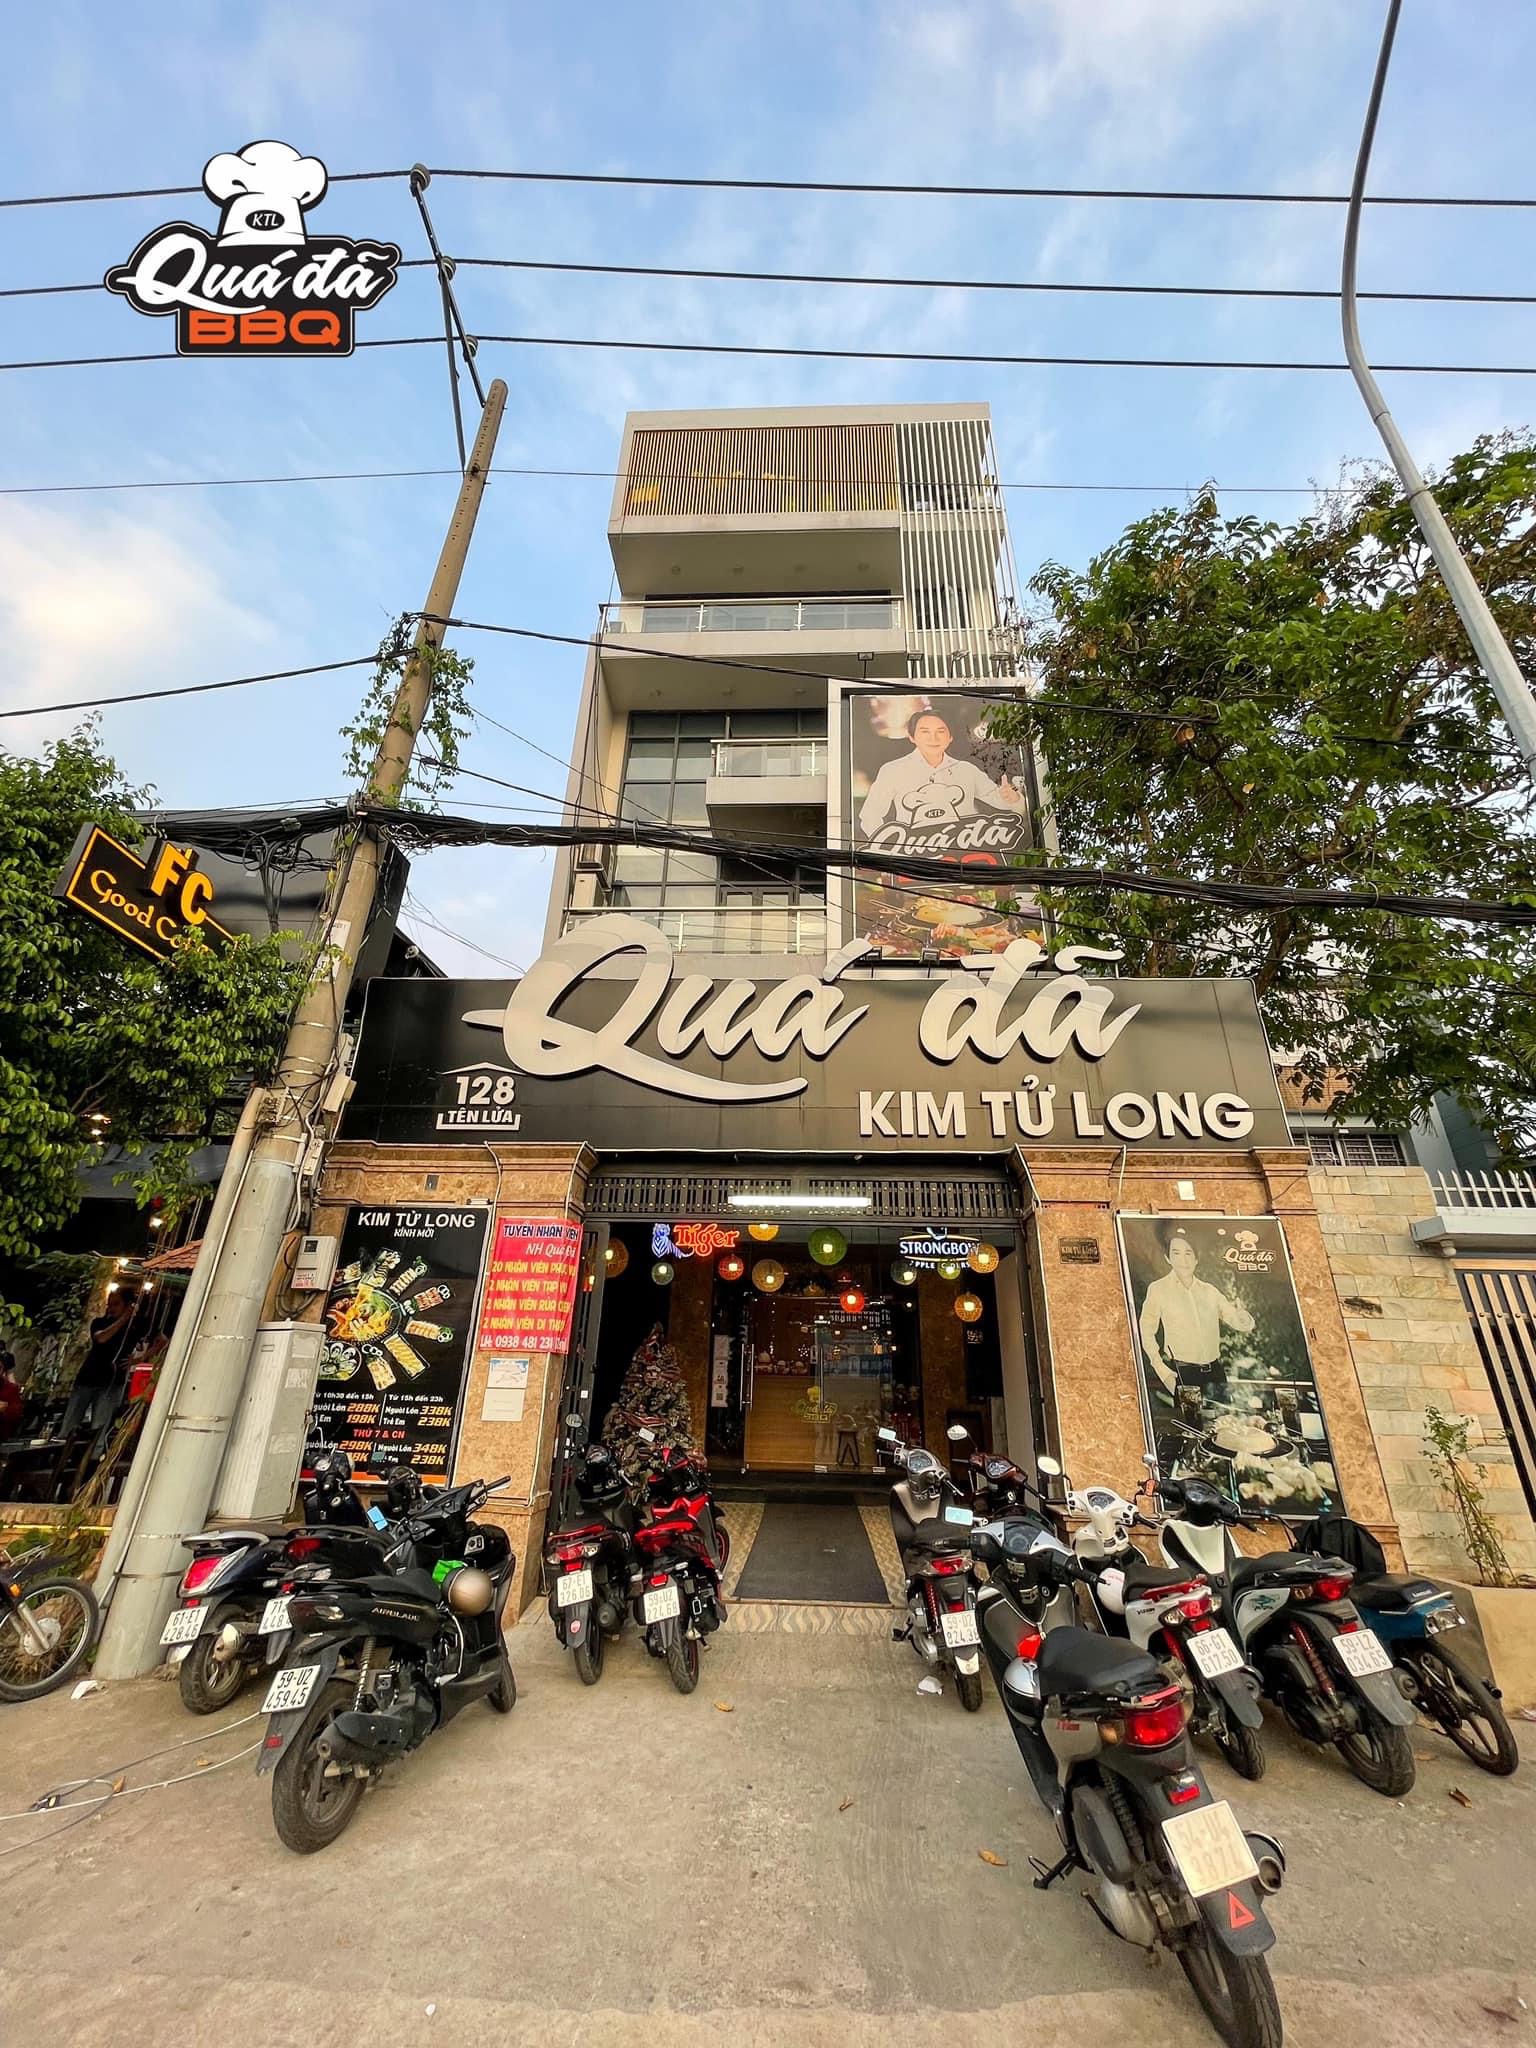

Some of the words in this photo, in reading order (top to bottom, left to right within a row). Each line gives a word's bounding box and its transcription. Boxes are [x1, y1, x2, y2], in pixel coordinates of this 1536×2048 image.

[957, 818, 1017, 848] đã
[90, 869, 155, 929] Good
[461, 913, 873, 1101] Quá
[919, 938, 1142, 1064] đã
[456, 1075, 515, 1106] 128
[447, 1106, 480, 1124] TÊN
[481, 1105, 513, 1124] LỬA
[858, 1090, 967, 1137] KIM
[981, 1074, 1056, 1138] TỬ
[1072, 1090, 1255, 1141] LONG
[357, 1211, 391, 1227] KIM
[395, 1209, 422, 1228] TỬ
[424, 1212, 477, 1228] LONG
[673, 1223, 740, 1257] Tiger
[495, 1335, 520, 1348] 0938
[313, 1402, 331, 1413] gười
